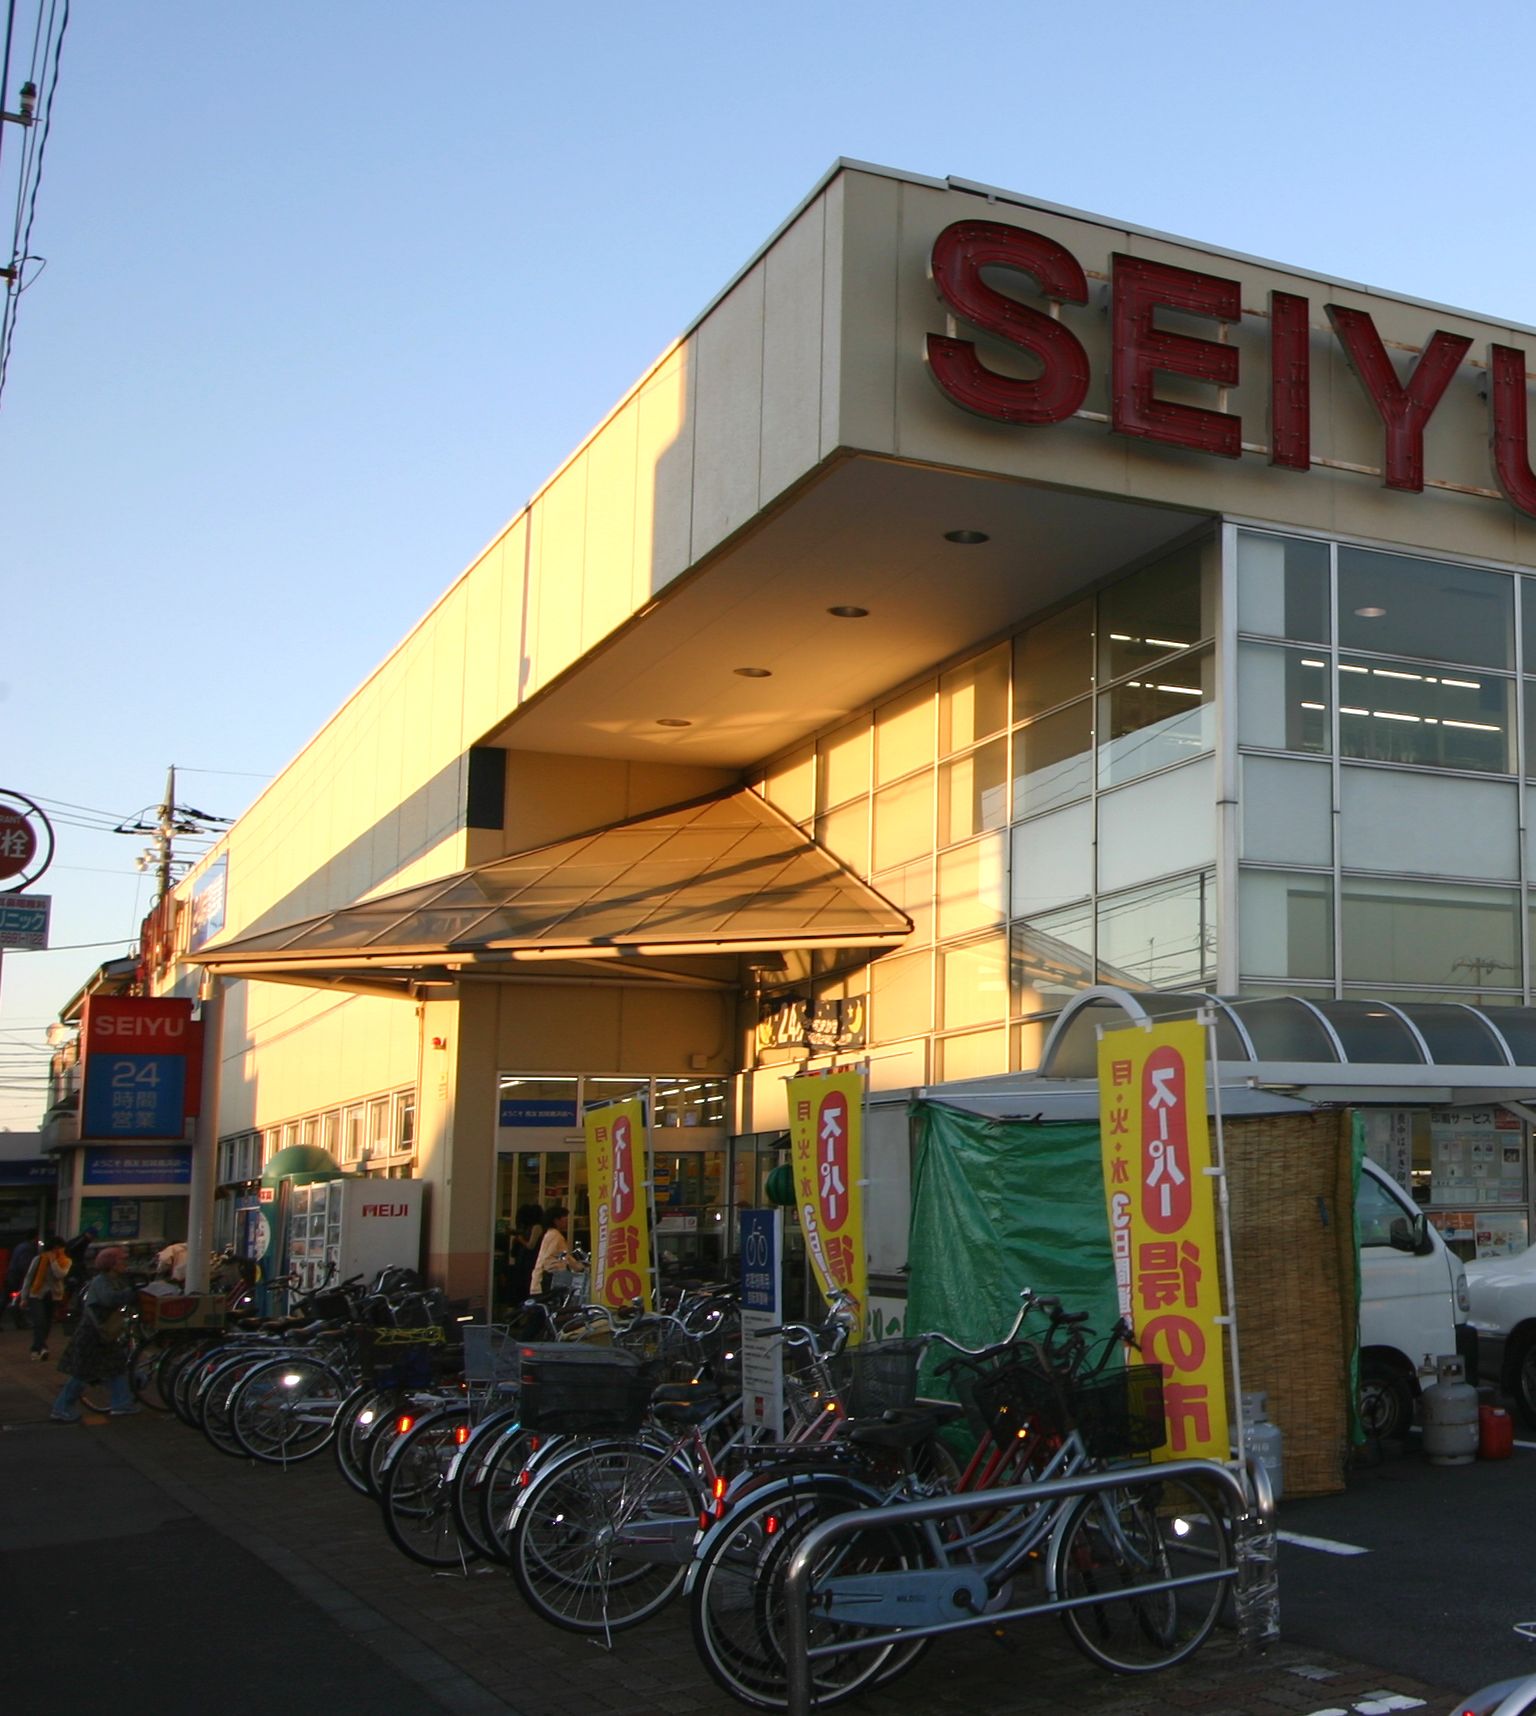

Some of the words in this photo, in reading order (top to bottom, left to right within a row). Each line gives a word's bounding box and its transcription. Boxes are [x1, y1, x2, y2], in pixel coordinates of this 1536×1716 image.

[95, 1015, 185, 1037] SEIYU
[111, 1061, 161, 1088] 24
[112, 1091, 158, 1110] 時間
[362, 1203, 409, 1217] MEIJI
